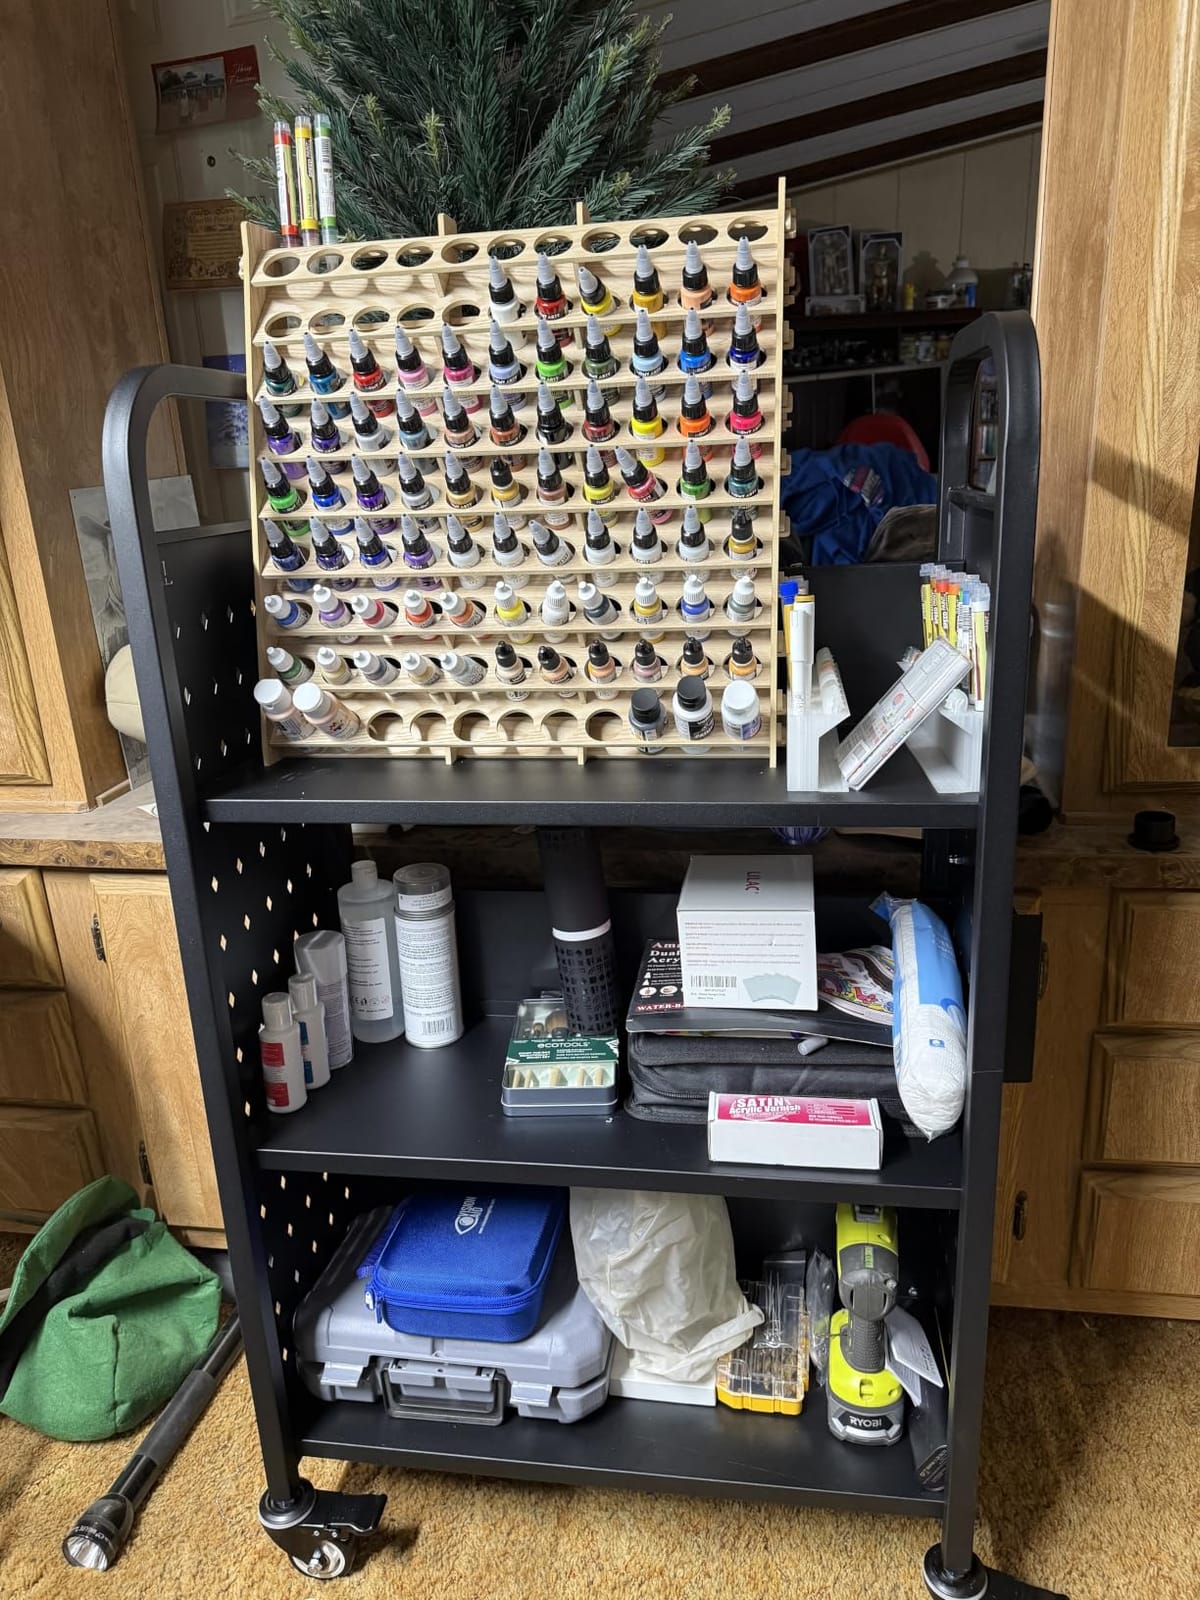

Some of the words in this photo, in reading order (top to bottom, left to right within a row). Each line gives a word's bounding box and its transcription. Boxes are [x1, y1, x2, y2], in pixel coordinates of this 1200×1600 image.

[736, 1096, 784, 1108] SATIN
[729, 1106, 763, 1115] Acrylic
[764, 1104, 801, 1113] Varnish
[849, 1415, 882, 1428] RYOBI
